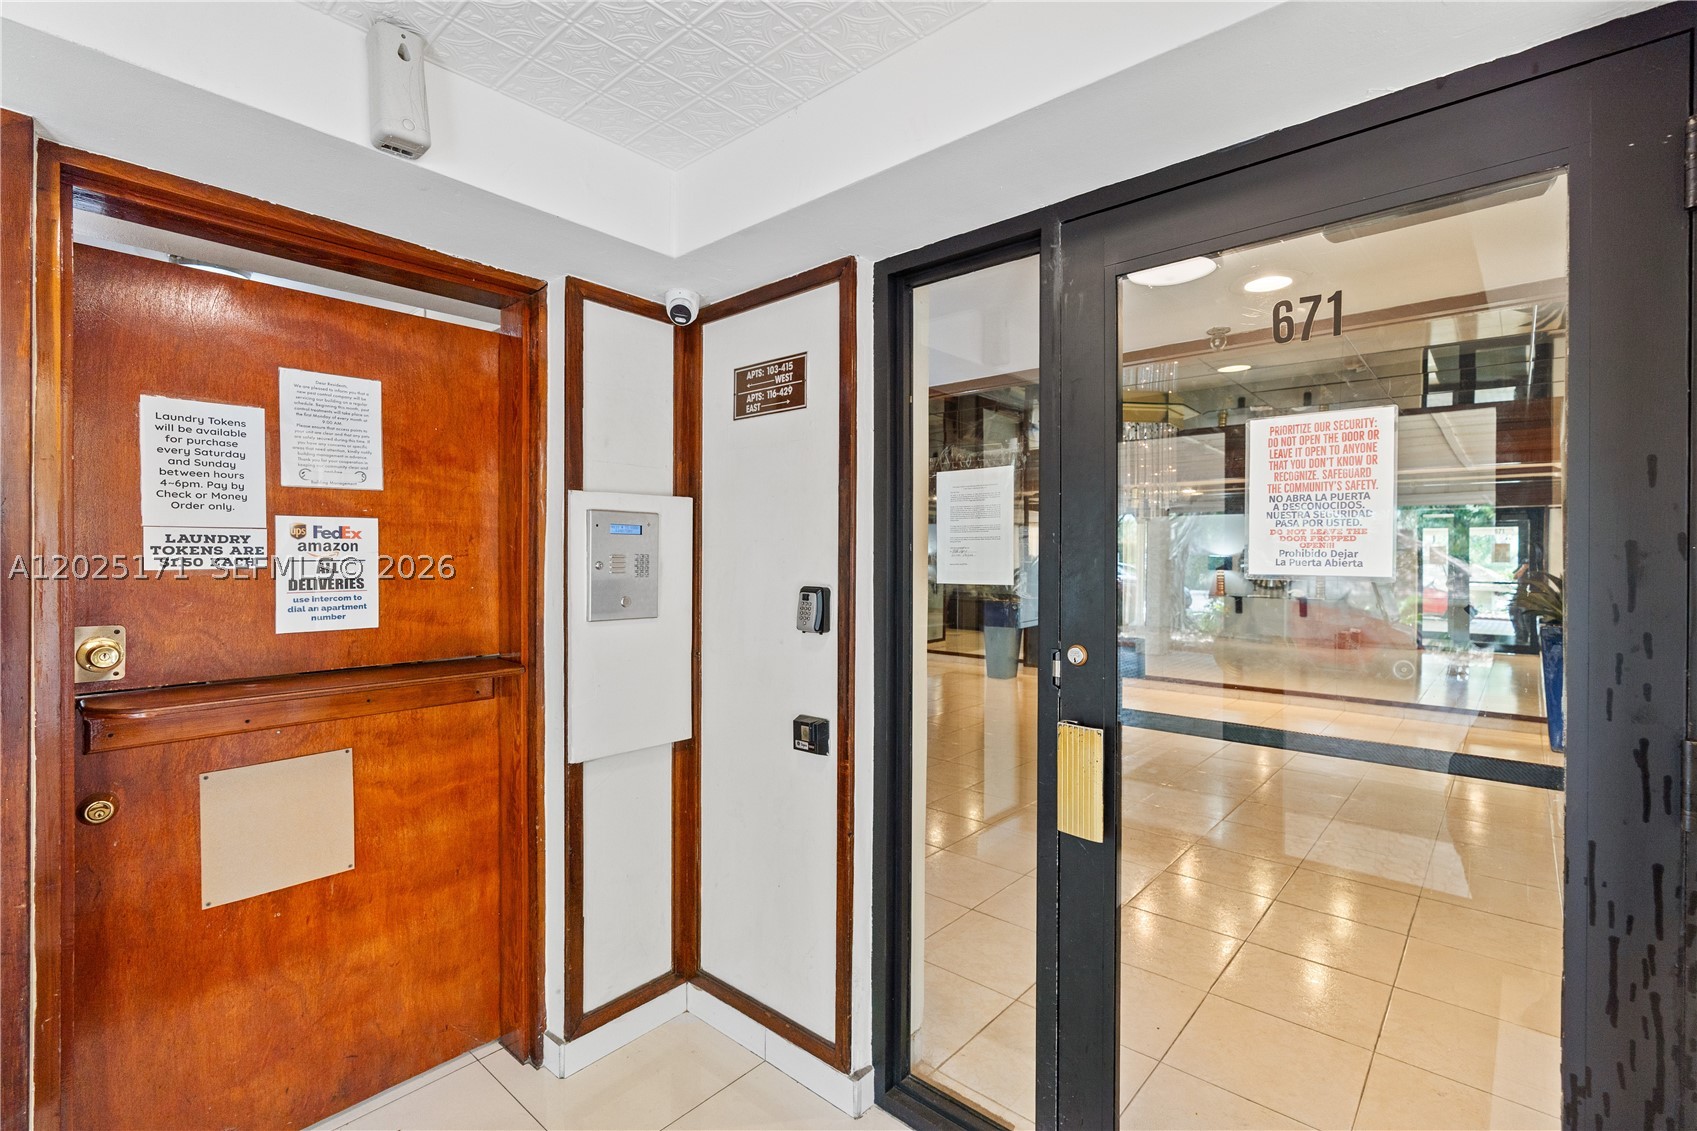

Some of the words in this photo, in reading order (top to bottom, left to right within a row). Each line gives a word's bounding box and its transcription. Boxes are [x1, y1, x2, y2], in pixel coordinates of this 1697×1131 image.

[1273, 290, 1342, 343] 671
[746, 369, 764, 380] APTS:
[767, 362, 793, 375] 103-415
[775, 372, 793, 383] WEST
[746, 392, 764, 403] APTS:
[767, 386, 793, 399] 116-429
[746, 403, 761, 413] EAST
[156, 412, 204, 425] Laundry
[208, 417, 246, 427] Tokens
[178, 425, 192, 433] be
[196, 428, 247, 437] available
[1270, 423, 1312, 436] PRIORITIZE
[1314, 421, 1331, 432] OUR
[1333, 418, 1377, 430] SECURITY:
[165, 435, 183, 443] for
[187, 438, 238, 447] purchase
[1268, 438, 1279, 448] DO
[1281, 436, 1297, 446] NOT
[1299, 434, 1320, 445] OPEN
[1323, 433, 1339, 443] THE
[1342, 431, 1365, 442] DOOR
[1368, 429, 1379, 440] OR
[157, 447, 190, 456] every
[194, 448, 246, 460] Saturday
[1270, 448, 1292, 459] LEAVE
[1295, 447, 1302, 457] IT
[1305, 446, 1326, 456] OPEN
[1329, 445, 1340, 455] TO
[1343, 442, 1377, 454] ANYONE
[194, 459, 236, 470] Sunday
[1269, 460, 1288, 470] THAT
[1290, 459, 1306, 469] YOU
[1337, 456, 1363, 466] KNOW
[1366, 454, 1378, 465] OR
[159, 468, 210, 477] between
[214, 471, 244, 479] hours
[1274, 470, 1319, 481] RECOGNIZE.
[1322, 467, 1371, 479] SAFEGUARD
[207, 481, 227, 491] Pay
[231, 482, 244, 491] by
[1267, 484, 1282, 493] THE
[1345, 479, 1378, 490] SAFETY.
[156, 490, 192, 498] Check
[212, 492, 247, 502] Money
[1269, 495, 1283, 503] NO
[1285, 494, 1312, 502] ABRA
[1330, 492, 1371, 501] PUERTA
[208, 503, 235, 512] only.
[1282, 501, 1365, 511] DESCONOCIDOS.
[1266, 511, 1311, 519] NUESTRA
[313, 525, 362, 539] FedEx
[165, 534, 251, 544] LAUNDRY
[150, 546, 223, 555] TOKENS
[230, 546, 264, 555] ARE
[298, 542, 358, 552] amazon
[1279, 549, 1327, 557] Prohibido
[1331, 549, 1358, 559] Dejar
[1324, 558, 1363, 567] Abierta
[288, 578, 364, 591] DELIVERIES
[321, 604, 367, 613] apartment
